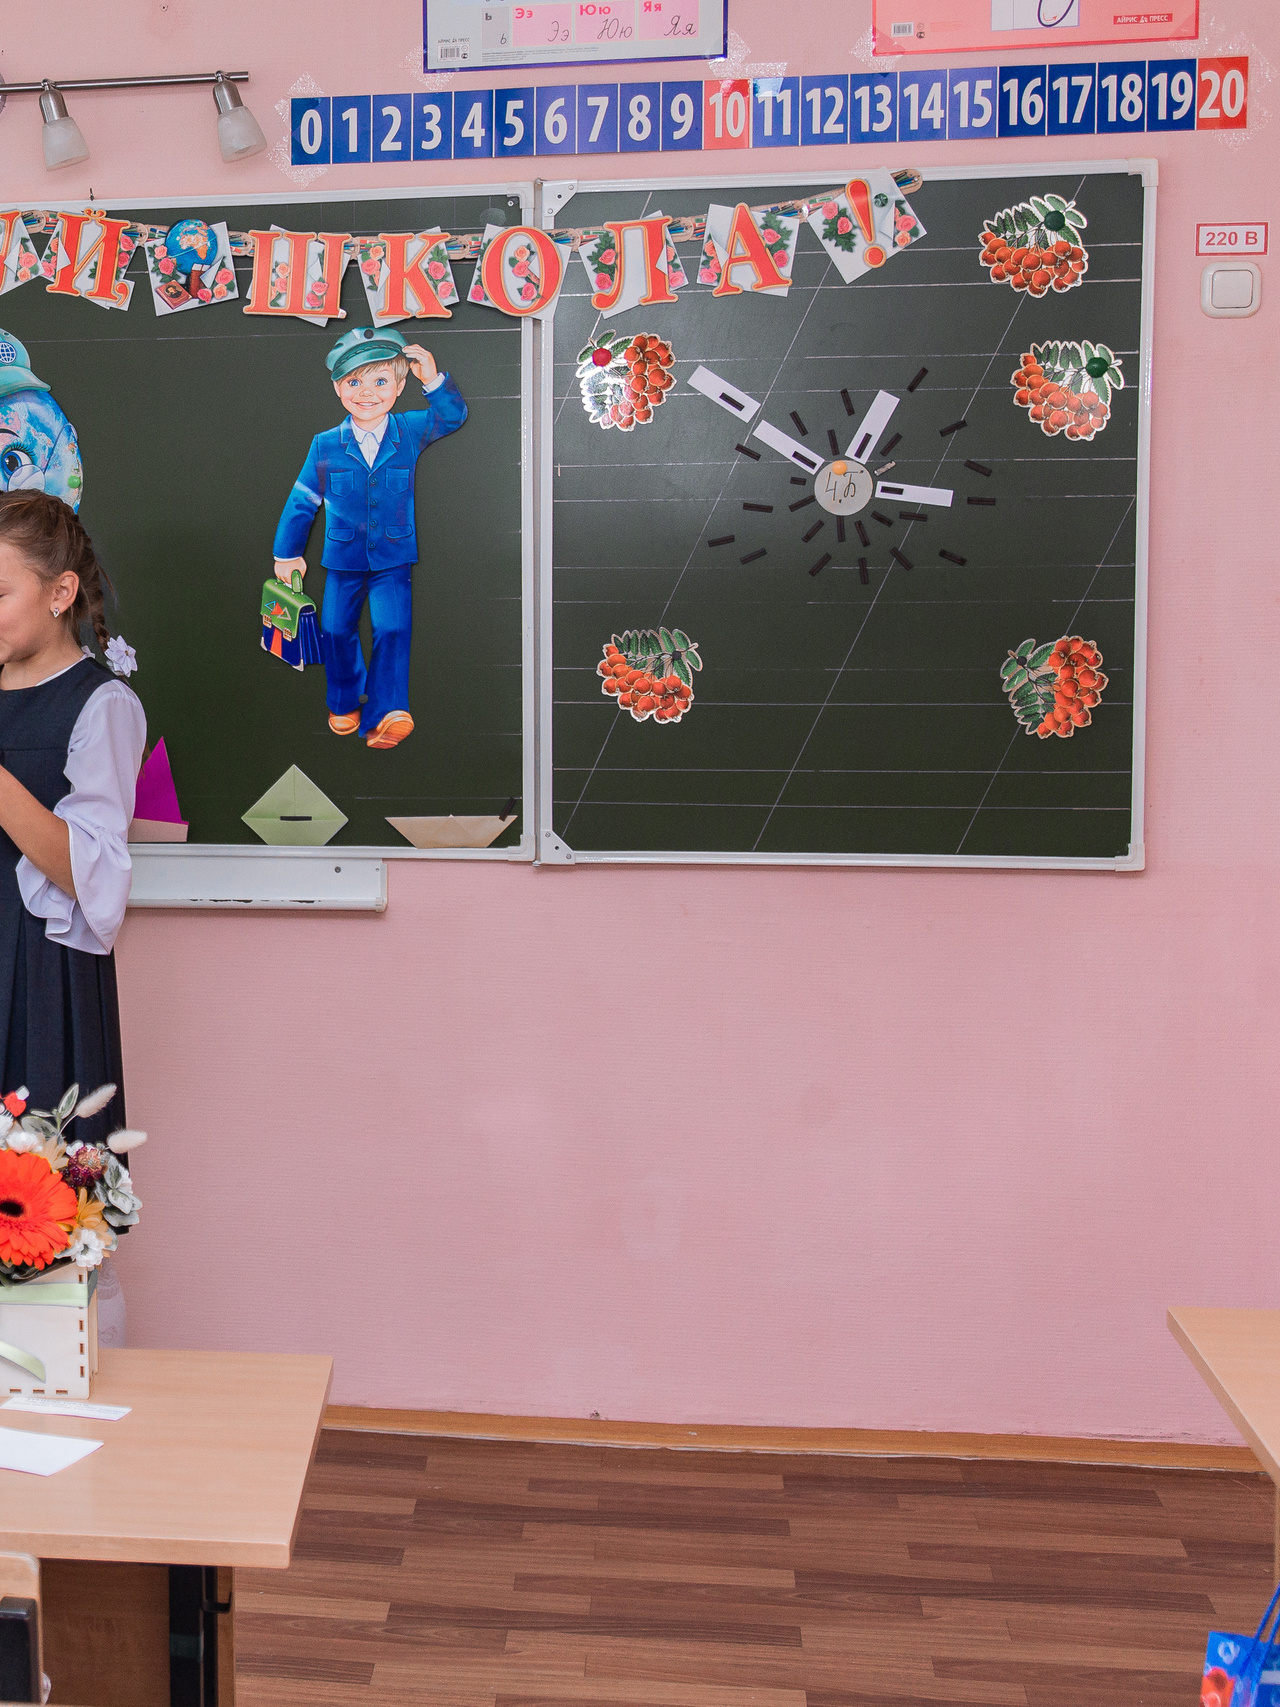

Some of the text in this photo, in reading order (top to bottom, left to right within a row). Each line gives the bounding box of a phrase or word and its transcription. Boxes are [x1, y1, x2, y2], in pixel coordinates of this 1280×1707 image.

[1116, 14, 1170, 23] АЙРИС ПРЕСС
[300, 69, 1244, 155] 0 1 2 3 4 5 6 7 8 9 10 11 12 13 14 15 16 17 18 19 20
[1205, 231, 1258, 246] 220 В
